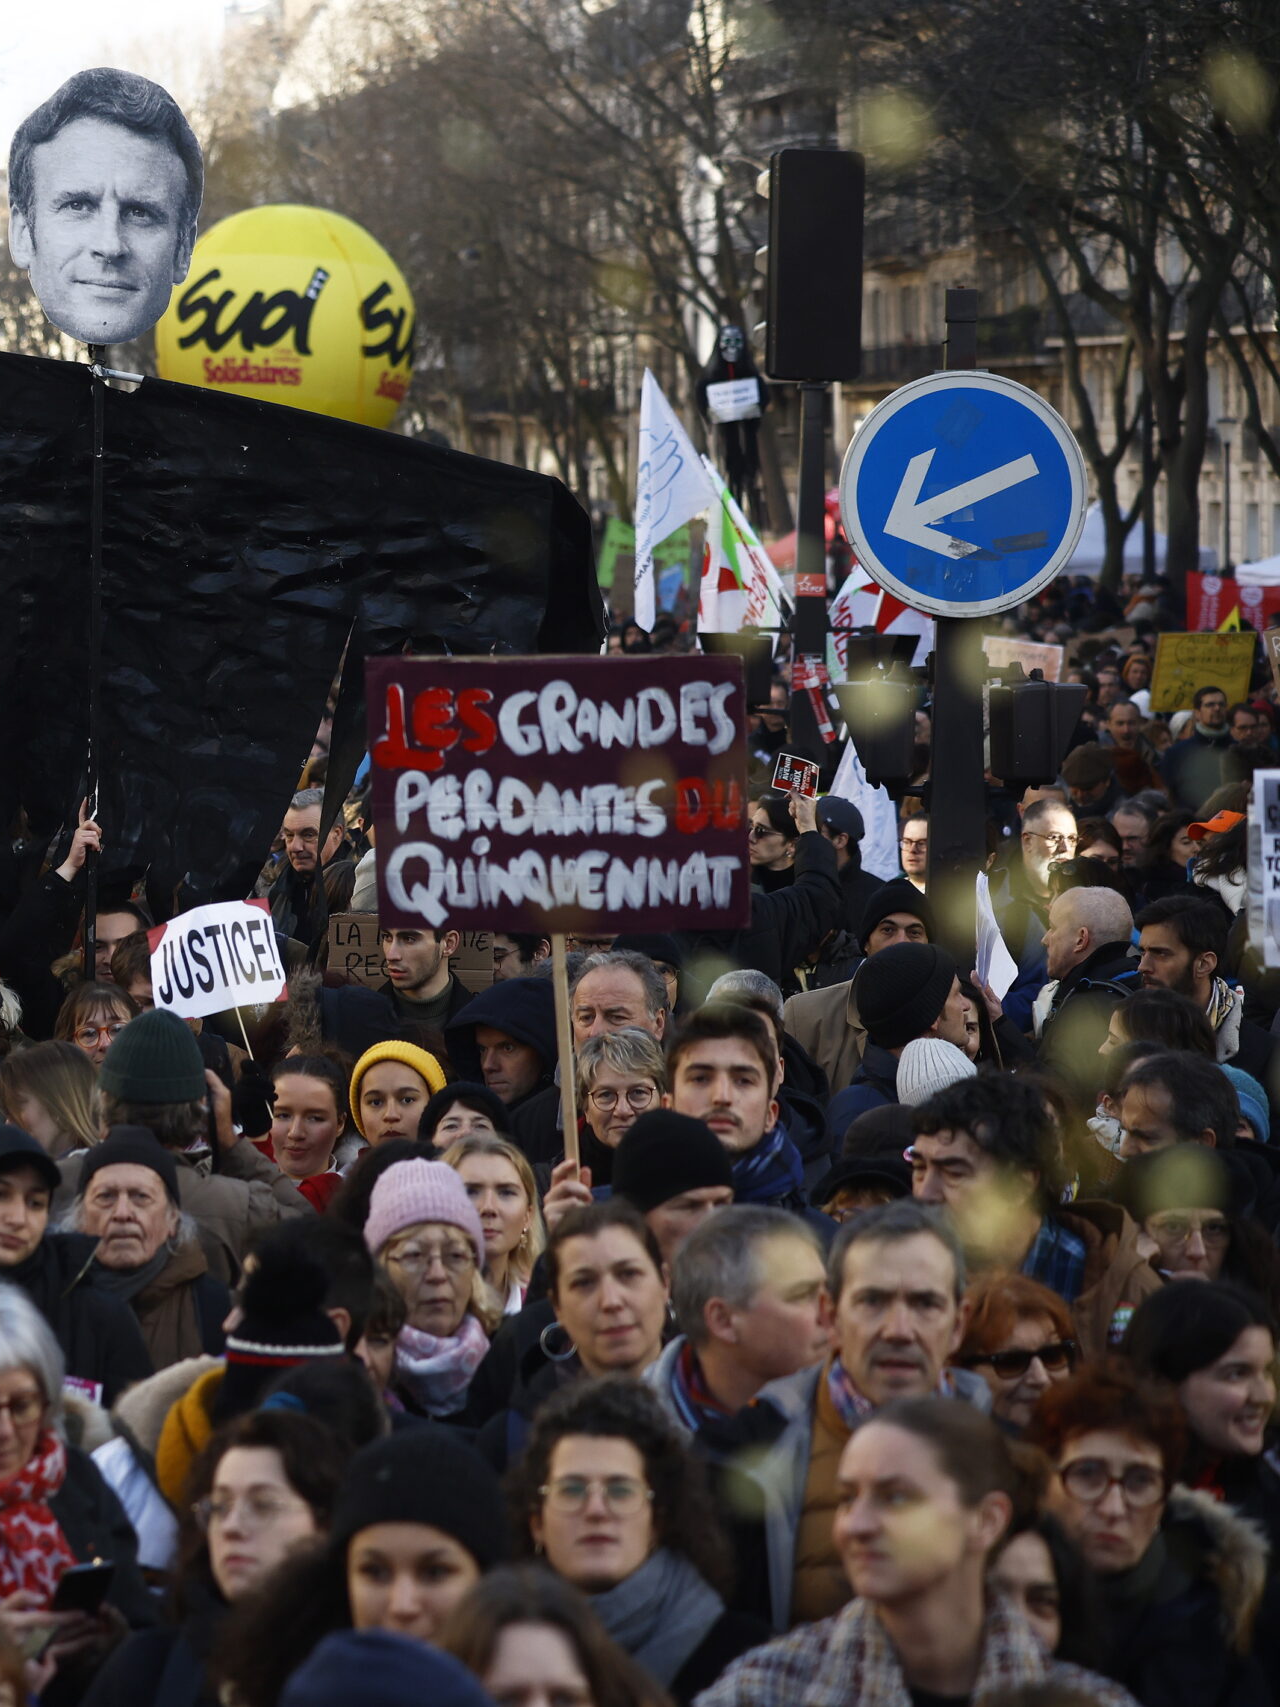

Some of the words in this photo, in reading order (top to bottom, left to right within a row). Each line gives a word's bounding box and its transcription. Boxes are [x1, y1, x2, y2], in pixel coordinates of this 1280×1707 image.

[202, 357, 302, 386] Solidaires
[373, 684, 498, 771] LES
[498, 680, 736, 756] GRANDES
[782, 757, 792, 780] AVENIR
[395, 768, 666, 840] PERDANTES
[675, 777, 741, 834] DU
[335, 922, 362, 947] LA
[159, 919, 281, 1005] JUSTICE!
